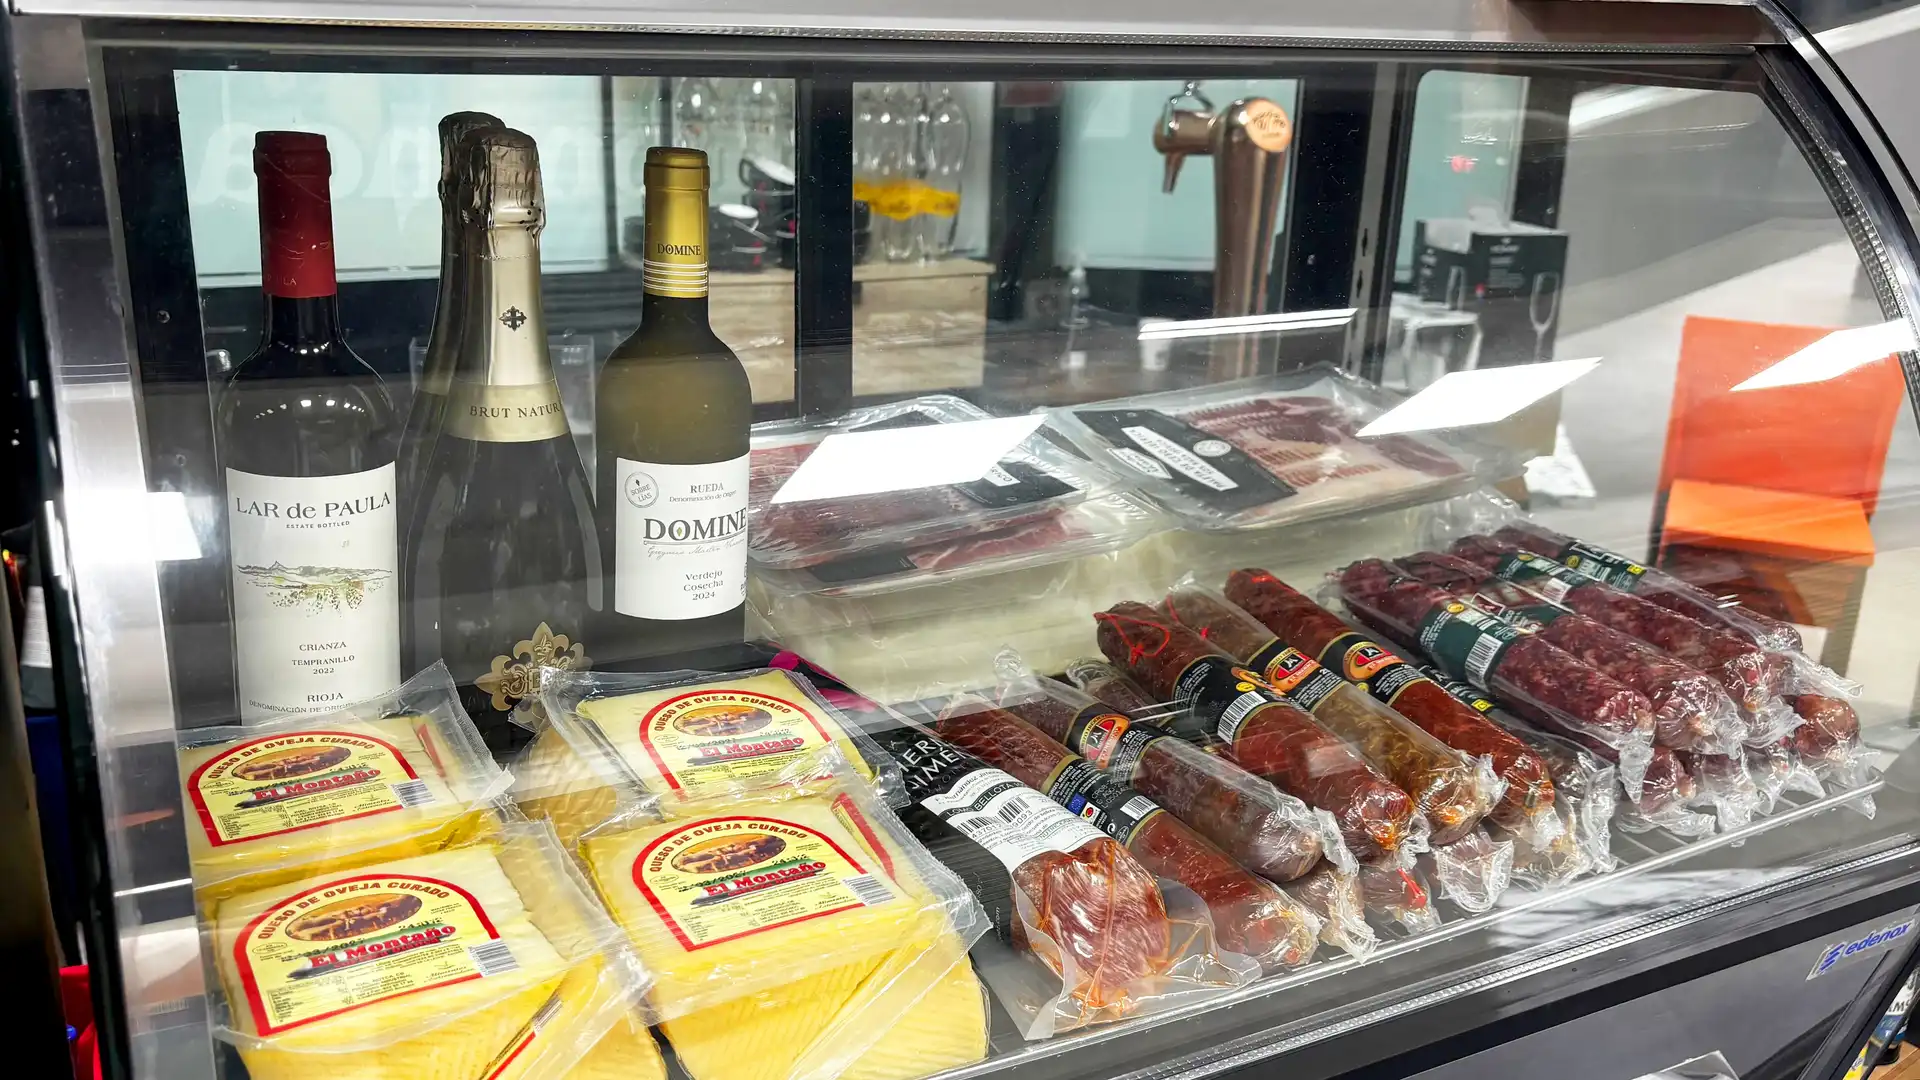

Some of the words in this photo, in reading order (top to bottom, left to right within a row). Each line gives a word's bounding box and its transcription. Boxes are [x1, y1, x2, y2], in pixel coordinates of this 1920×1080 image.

[657, 244, 702, 256] DOMINE
[469, 405, 510, 418] BRUT
[518, 402, 562, 418] NATUR
[630, 484, 651, 496] SOBRE
[690, 483, 724, 494] RUEDA
[236, 498, 280, 518] LAR
[287, 503, 316, 519] de
[324, 492, 390, 517] PAULA
[638, 493, 652, 502] LÍAS
[643, 507, 746, 541] DOMINE
[685, 570, 722, 581] Verdejo
[683, 580, 724, 592] Cosecha
[692, 592, 715, 600] 2024
[299, 642, 347, 651] CRIANZA
[292, 655, 355, 666] TEMPRANILLO
[307, 693, 344, 702] RIOJA
[249, 700, 307, 713] DENOMINACIÓN
[654, 707, 678, 731] QUESO
[677, 700, 694, 710] DE
[695, 695, 737, 704] OVEJA
[740, 696, 791, 714] CURADO
[1122, 730, 1136, 744] 250
[699, 745, 720, 758] El
[726, 736, 805, 756] Montaño
[208, 756, 240, 779] QUESO
[244, 746, 262, 758] DE
[264, 737, 315, 750] OVEJA
[319, 737, 376, 750] CURADO
[254, 788, 280, 801] El
[286, 767, 382, 794] Montaño
[974, 783, 1013, 811] BELLOTA
[649, 845, 674, 872] QUESO
[674, 834, 692, 846] DE
[694, 823, 742, 837] OVEJA
[747, 823, 809, 839] CURADO
[704, 882, 730, 896] El
[734, 860, 827, 888] Montaño
[257, 909, 296, 940] QUESO
[300, 895, 320, 909] DE
[324, 882, 381, 899] OVEJA
[387, 882, 451, 899] CURADO
[308, 951, 340, 968] El
[345, 924, 457, 957] Montaño
[1845, 924, 1911, 955] edenox
